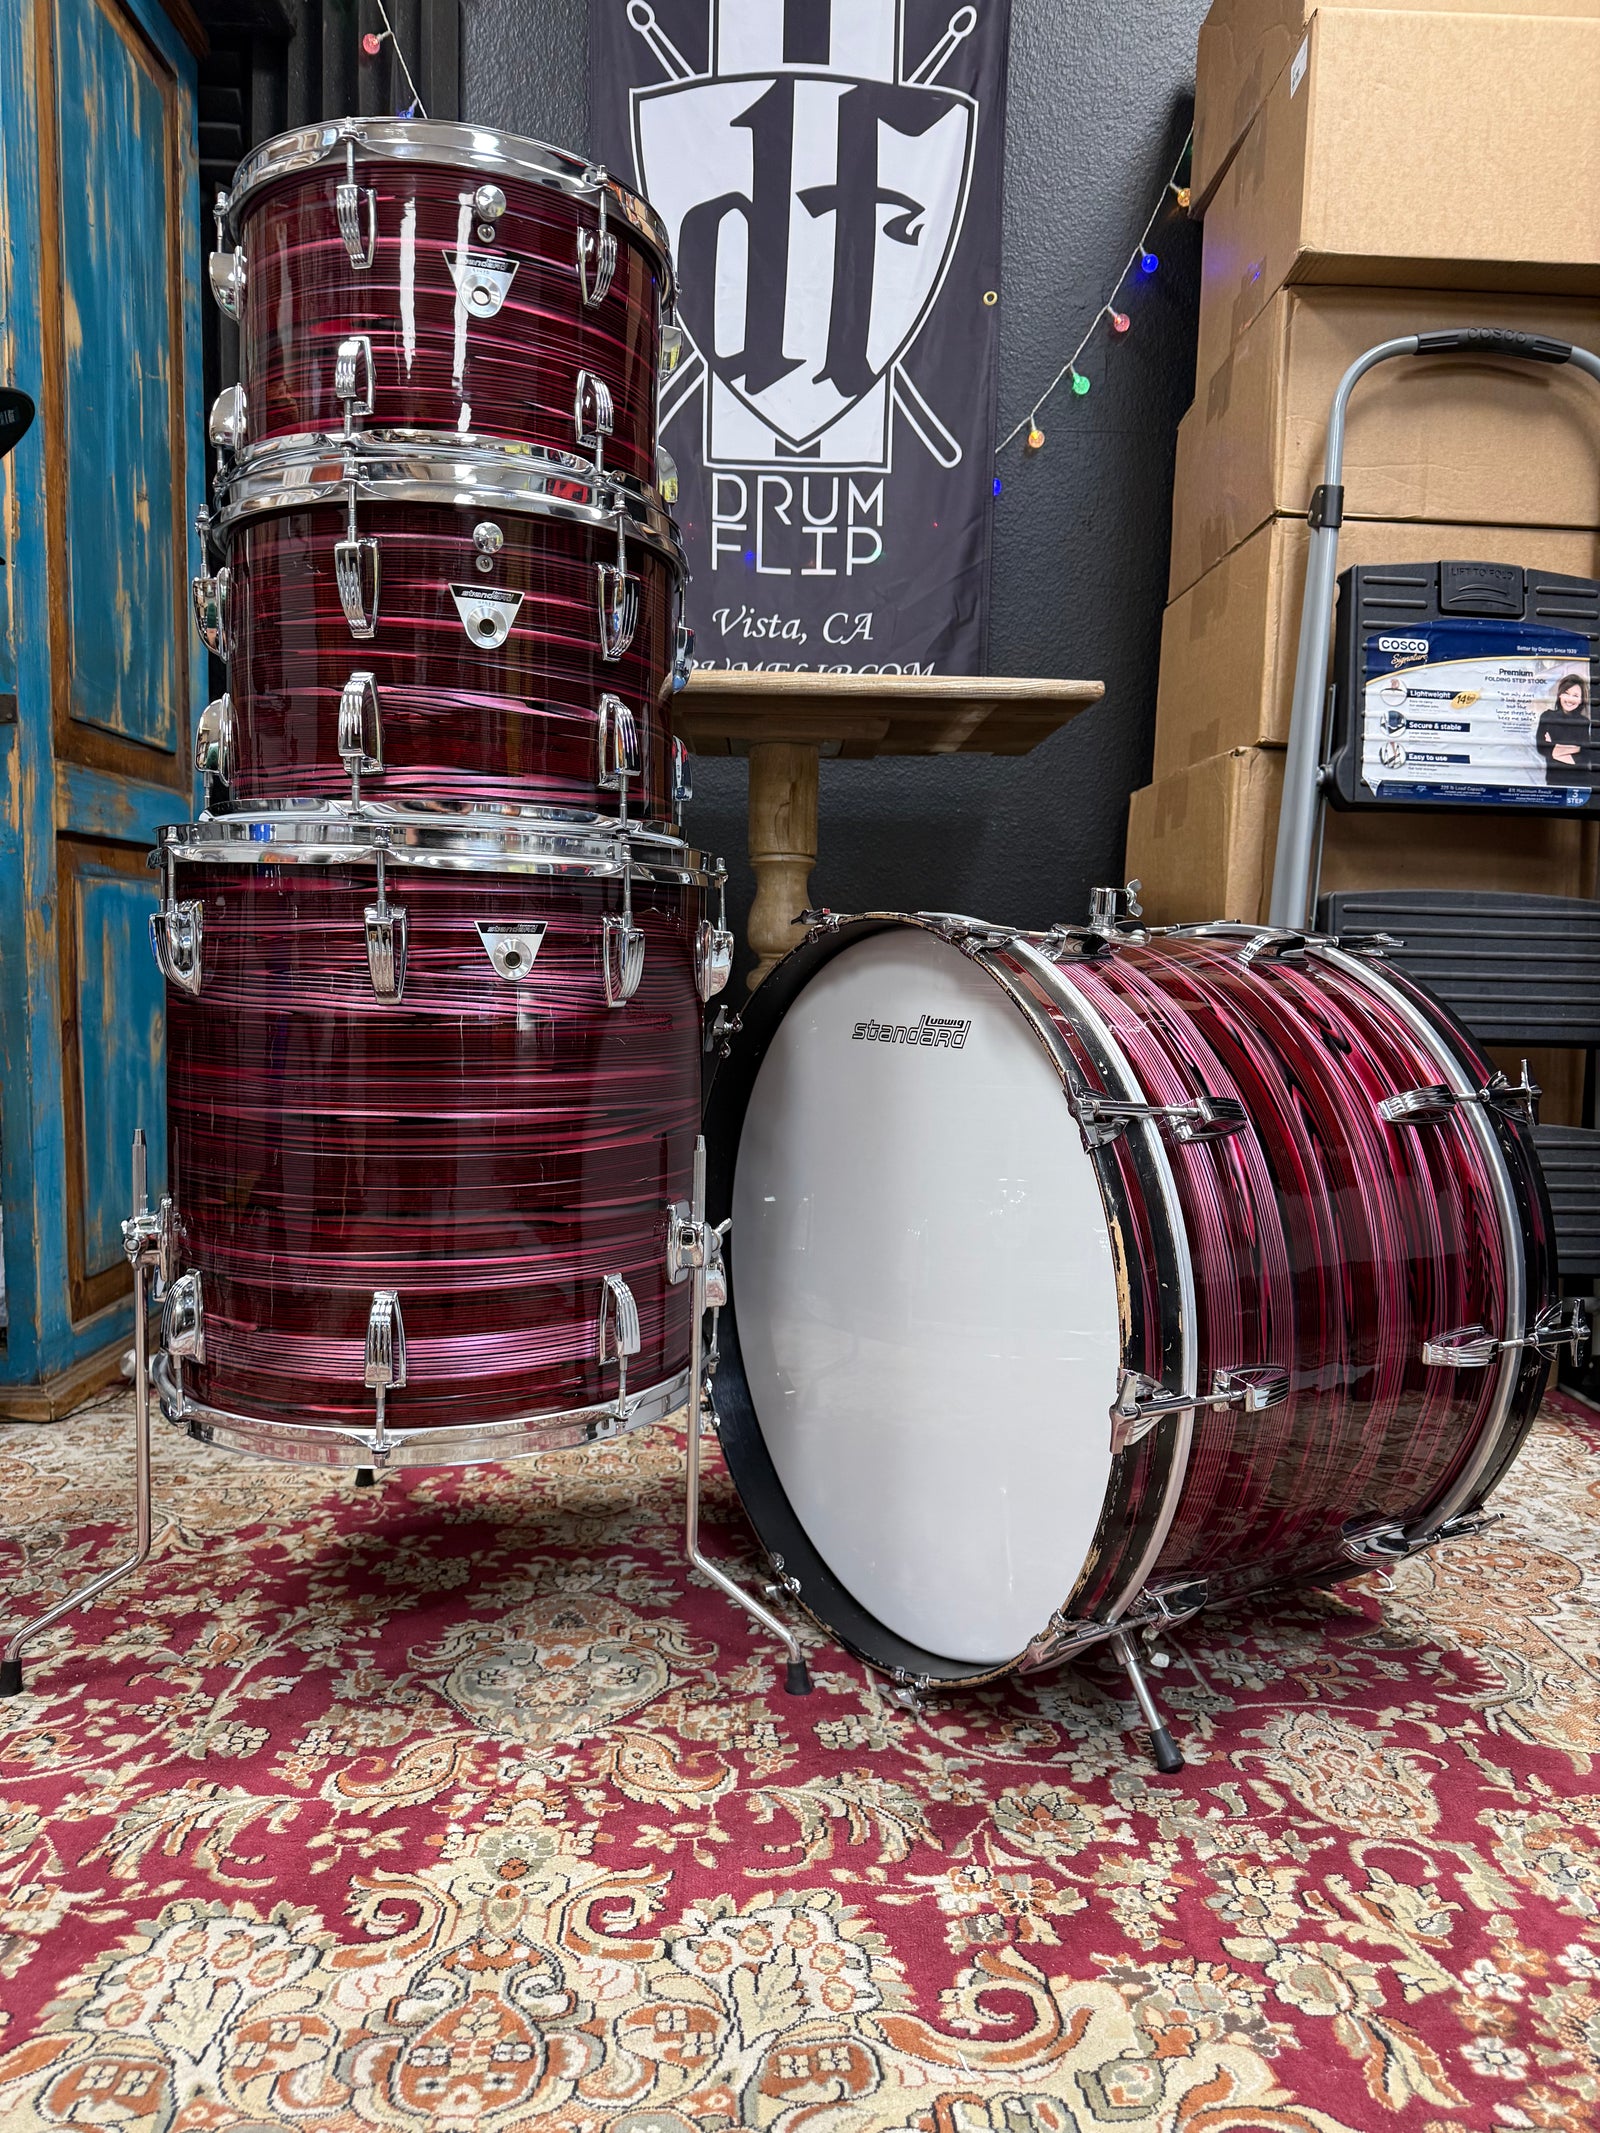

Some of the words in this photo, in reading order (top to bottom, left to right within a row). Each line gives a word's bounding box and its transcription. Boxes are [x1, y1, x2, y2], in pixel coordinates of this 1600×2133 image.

[1468, 327, 1527, 343] COSCO
[711, 472, 884, 527] DRUM
[711, 521, 884, 576] FLIP
[1451, 567, 1472, 576] LIFT
[1473, 568, 1486, 577] TO
[1489, 569, 1514, 581] FOLD
[711, 605, 808, 644] Vista,
[822, 612, 874, 646] CA
[1381, 639, 1427, 652] COSCO
[1499, 668, 1534, 678] Premium
[1410, 690, 1451, 699] Lightweight
[1440, 723, 1462, 731] stable
[1408, 753, 1425, 762] Easy
[1572, 789, 1579, 798] 3
[1566, 797, 1584, 805] STEP
